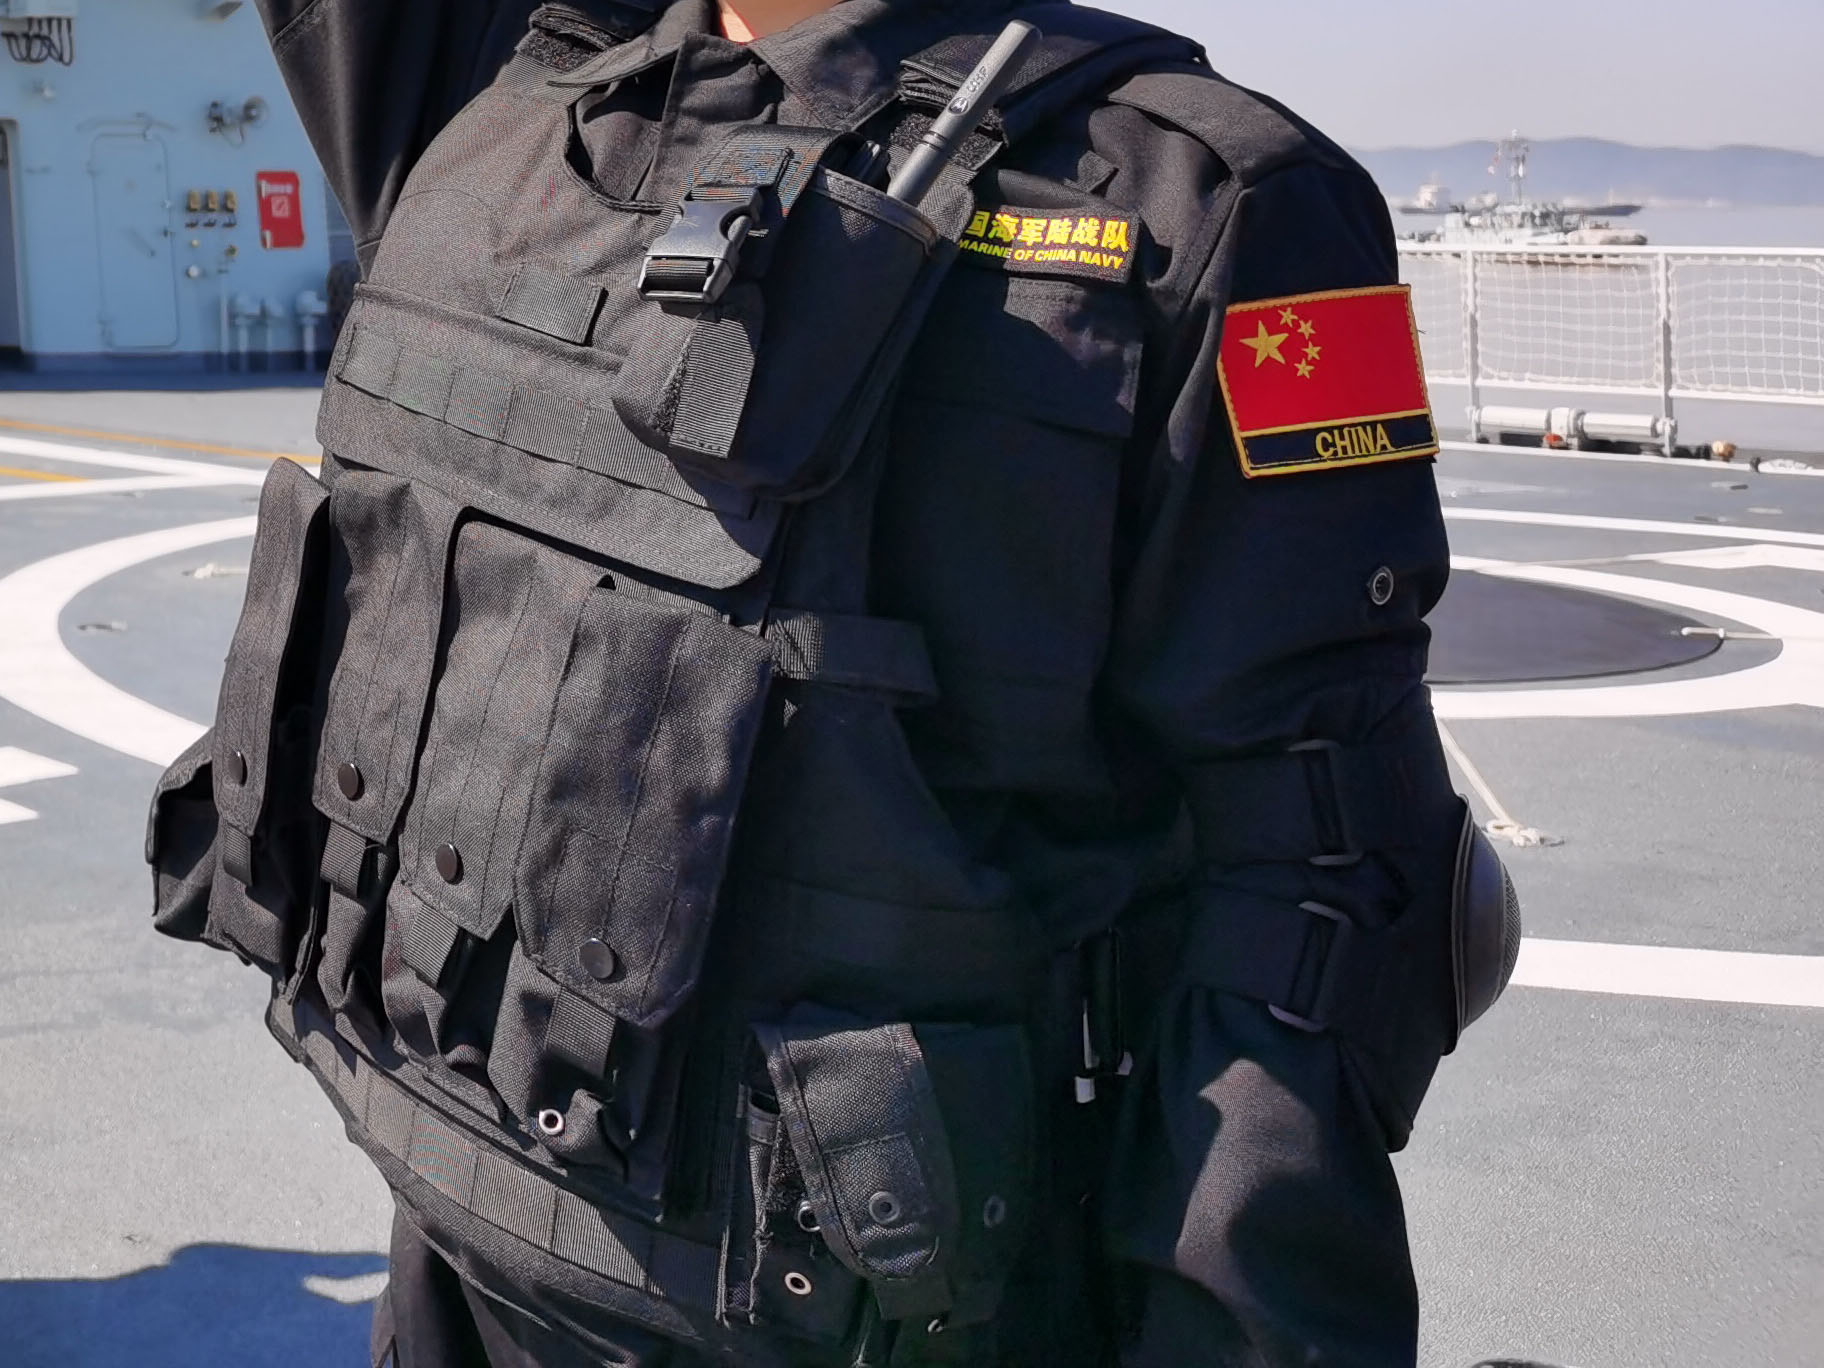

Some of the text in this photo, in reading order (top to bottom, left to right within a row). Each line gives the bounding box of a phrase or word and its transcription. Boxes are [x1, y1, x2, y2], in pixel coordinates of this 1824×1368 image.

[964, 210, 1129, 253] 国海军陆战队
[958, 238, 1125, 270] MARINE OF CHINA NAVY
[1315, 423, 1395, 459] CHINA
